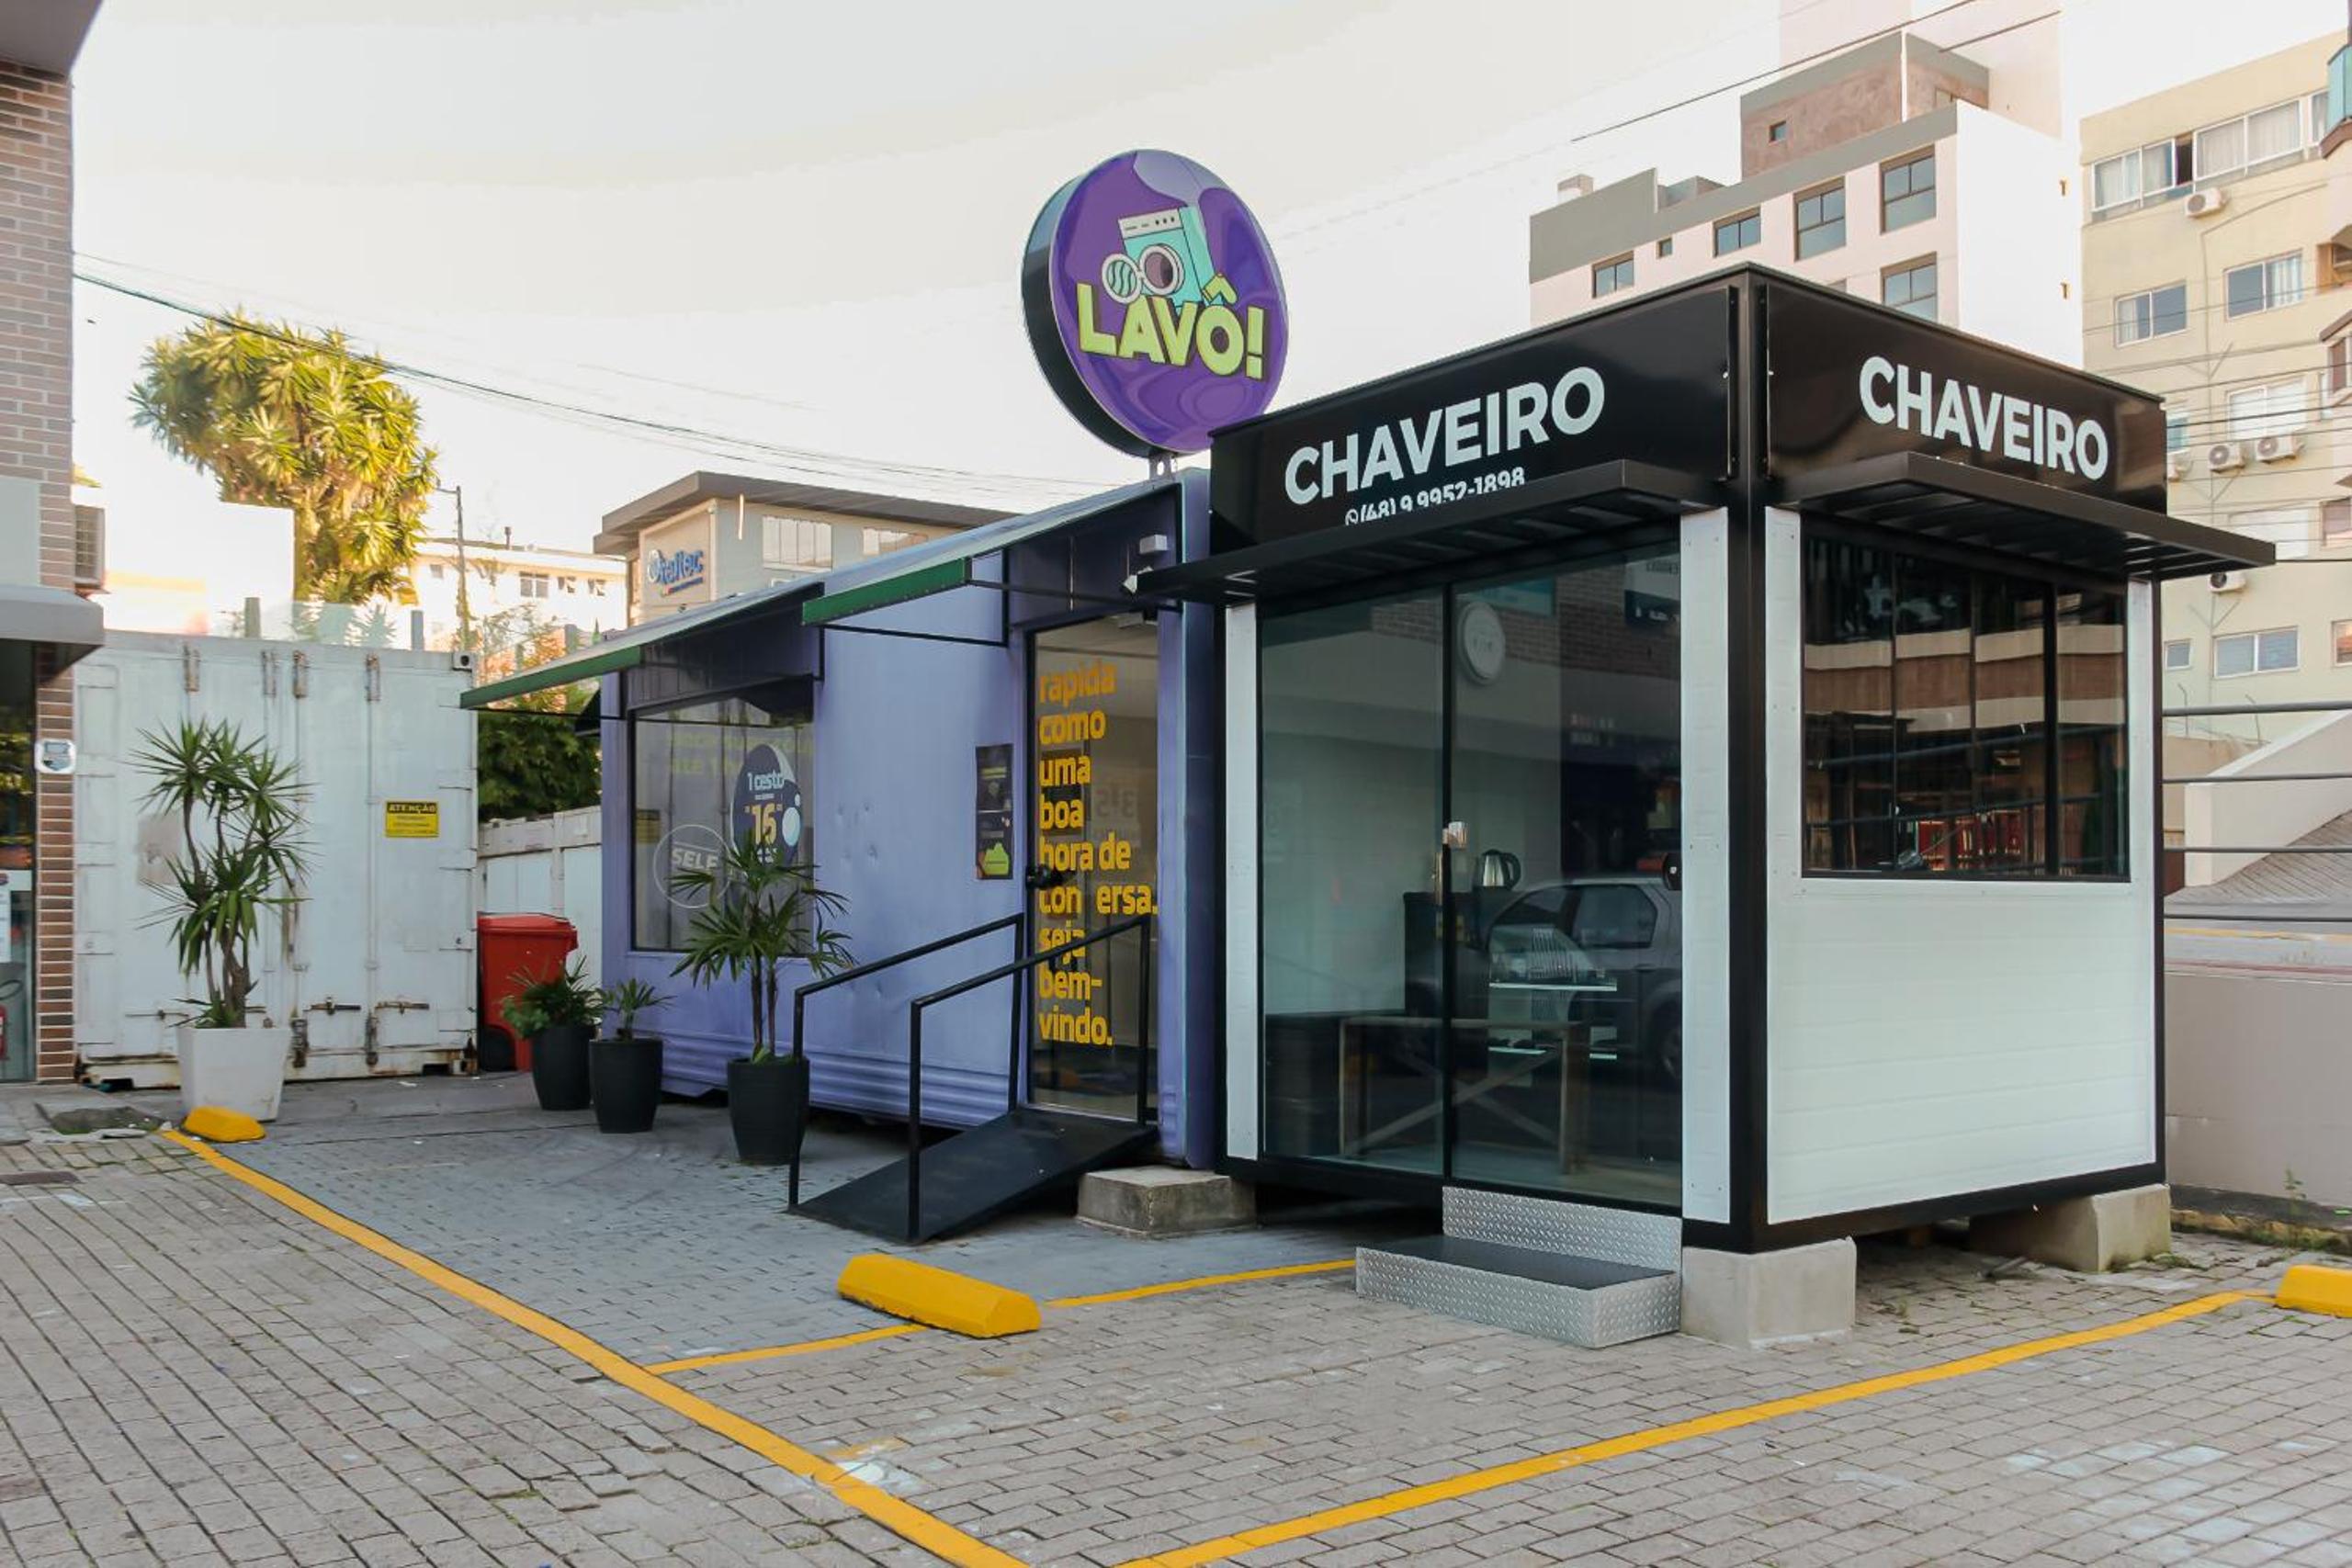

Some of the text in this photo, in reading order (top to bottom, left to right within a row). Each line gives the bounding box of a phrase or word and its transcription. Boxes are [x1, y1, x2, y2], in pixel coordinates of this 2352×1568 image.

[1077, 274, 1264, 380] LAVÔ!
[1284, 367, 1605, 505] CHAVEIRO
[1859, 355, 2109, 480] CHAVEIRO
[1039, 710, 1106, 745] como
[1039, 755, 1091, 787] uma
[1039, 794, 1085, 830] boa
[1039, 831, 1132, 872] hora de
[1039, 920, 1086, 964] seja
[1039, 1005, 1114, 1047] vindo.
